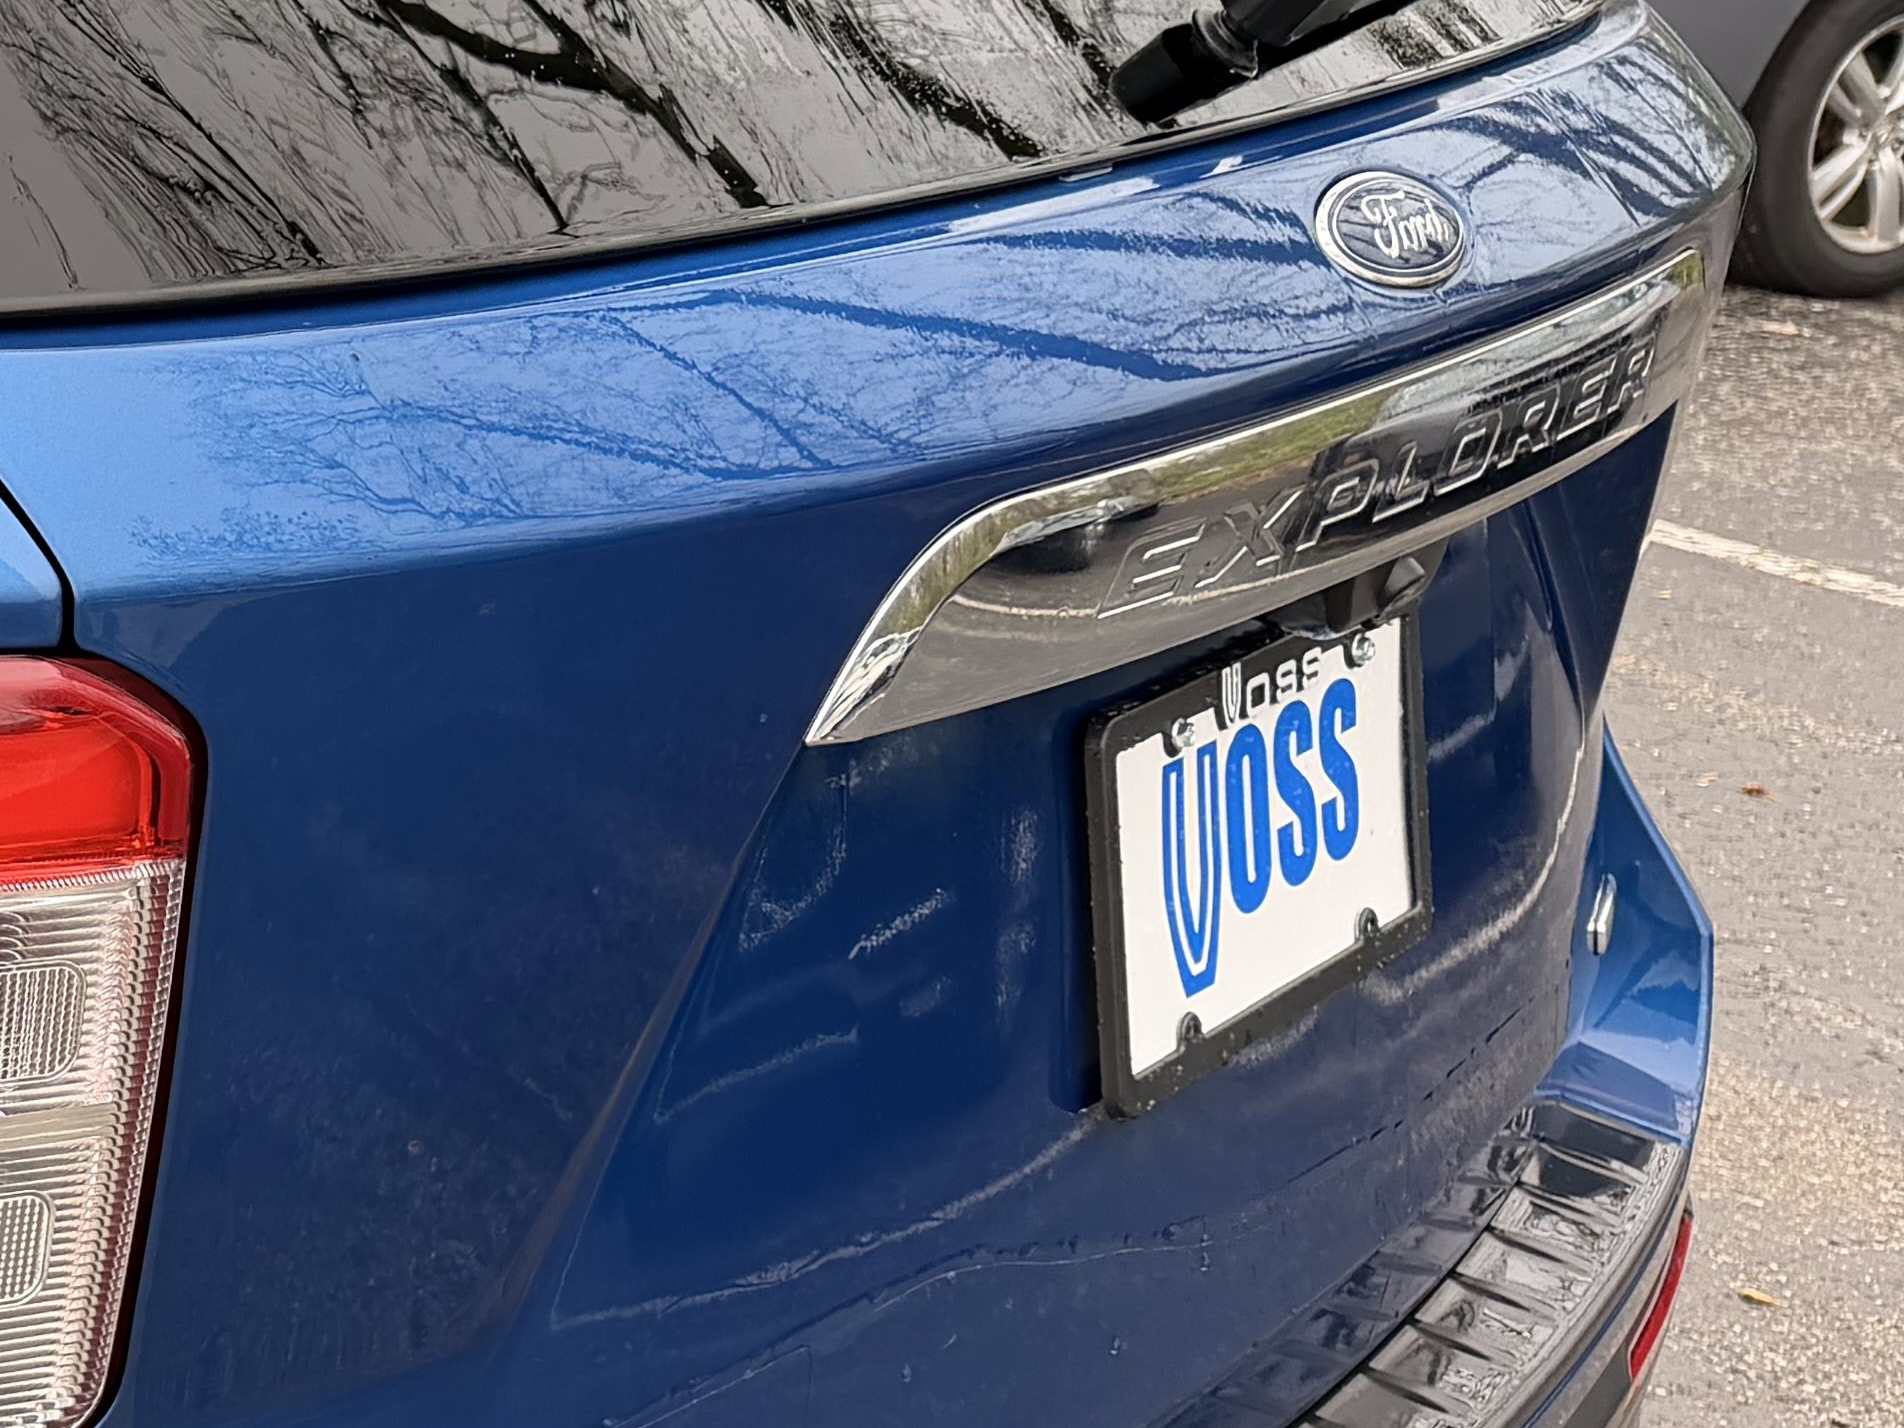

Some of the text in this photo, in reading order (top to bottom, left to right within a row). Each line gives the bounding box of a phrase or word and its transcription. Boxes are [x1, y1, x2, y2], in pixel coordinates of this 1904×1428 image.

[1360, 190, 1450, 259] Ford
[1097, 334, 1656, 620] EXPLORER
[1161, 677, 1360, 998] VOSS
